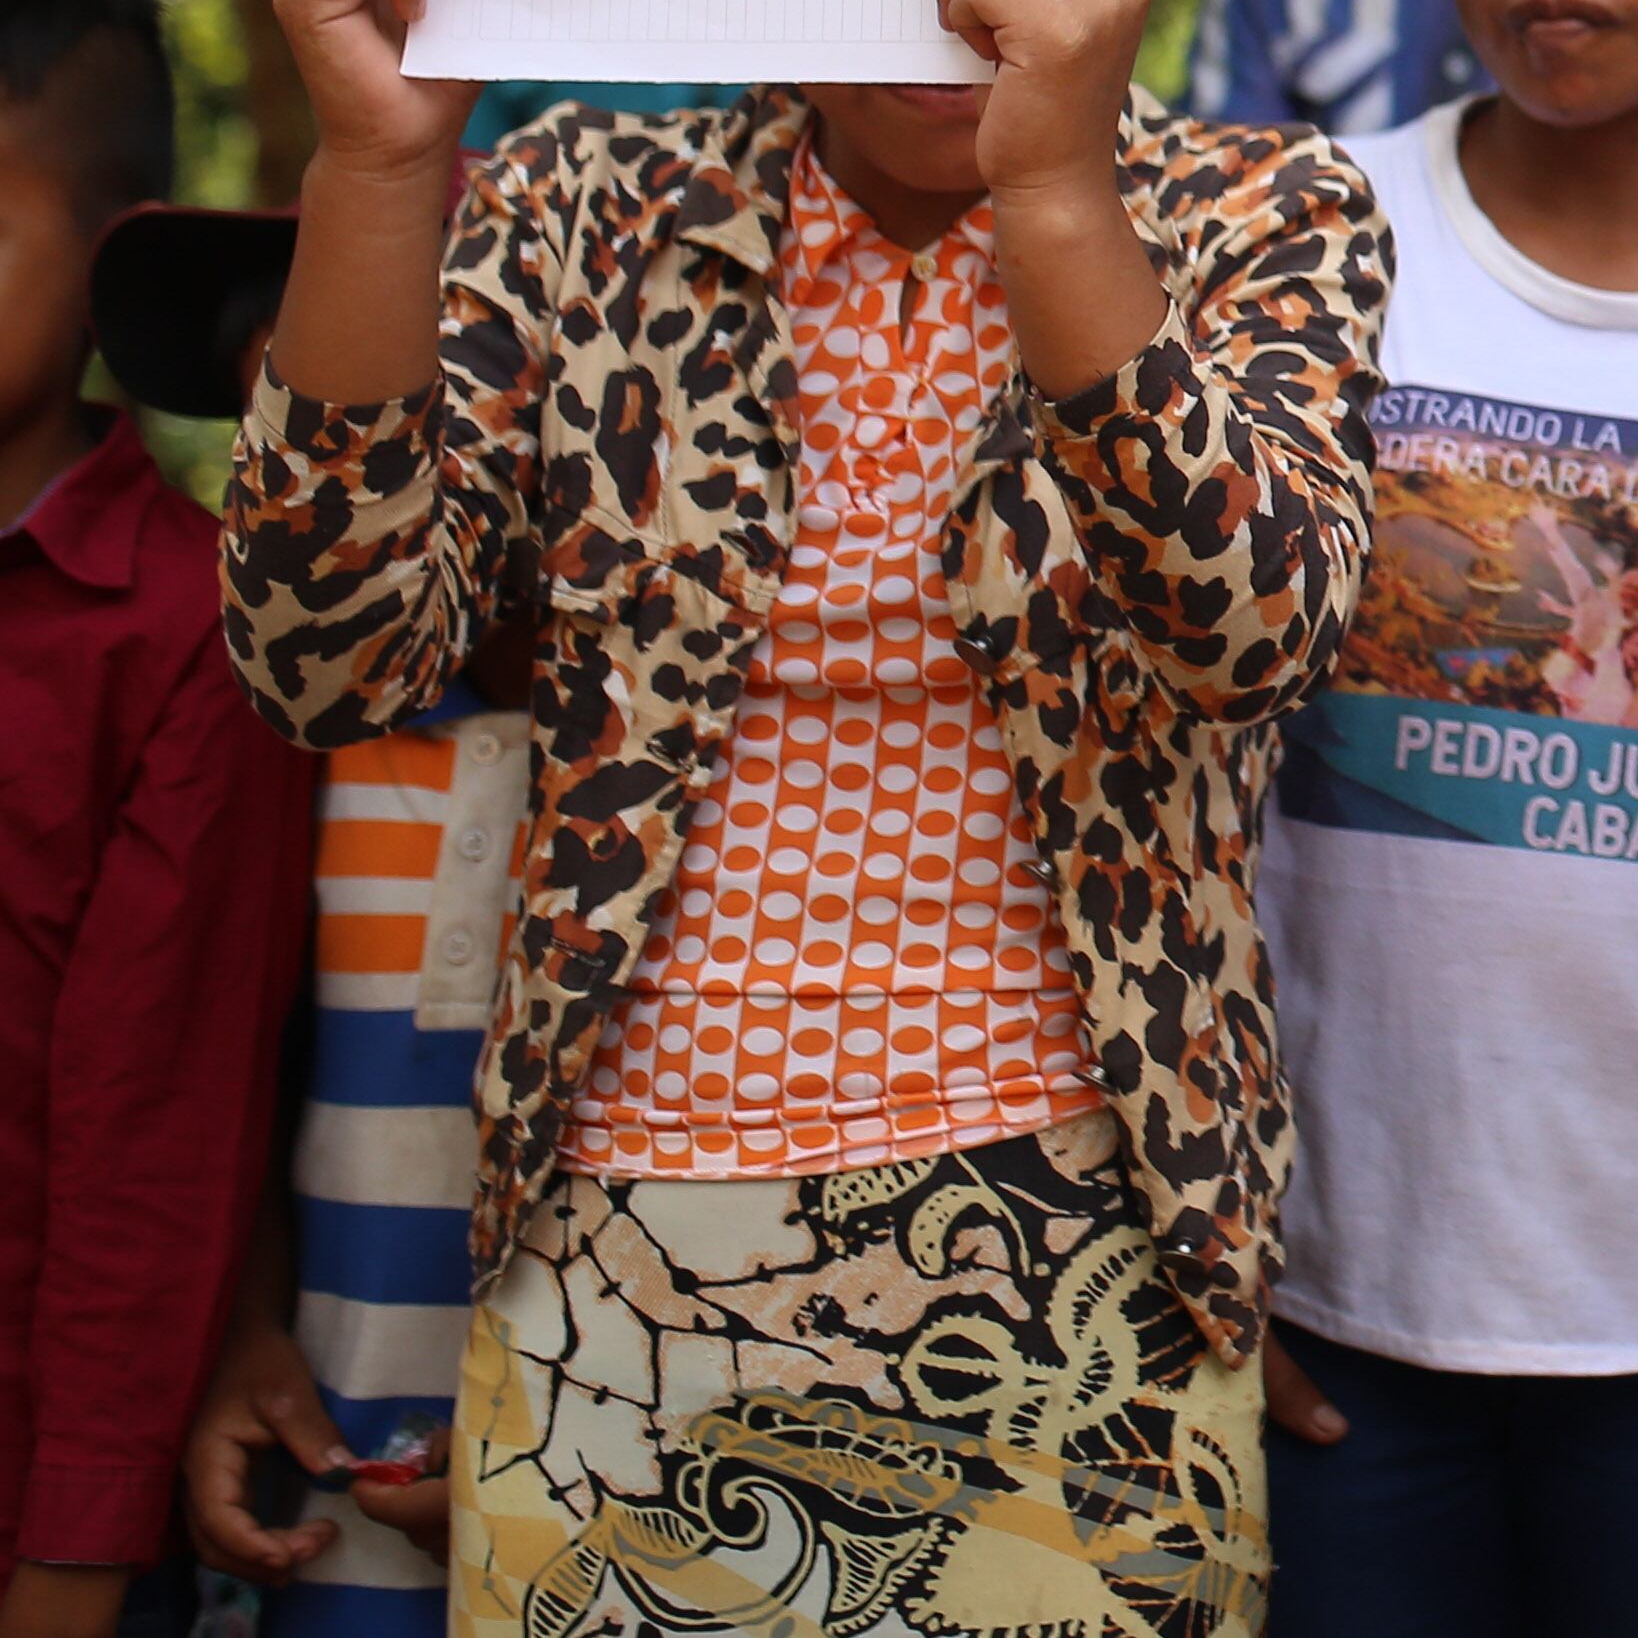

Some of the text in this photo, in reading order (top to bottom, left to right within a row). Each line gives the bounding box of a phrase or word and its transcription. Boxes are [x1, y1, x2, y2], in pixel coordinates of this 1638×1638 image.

[1376, 430, 1487, 483] DERA
[1500, 449, 1611, 500] CARA
[1572, 419, 1622, 453] LA
[1396, 715, 1580, 790] PEDRO
